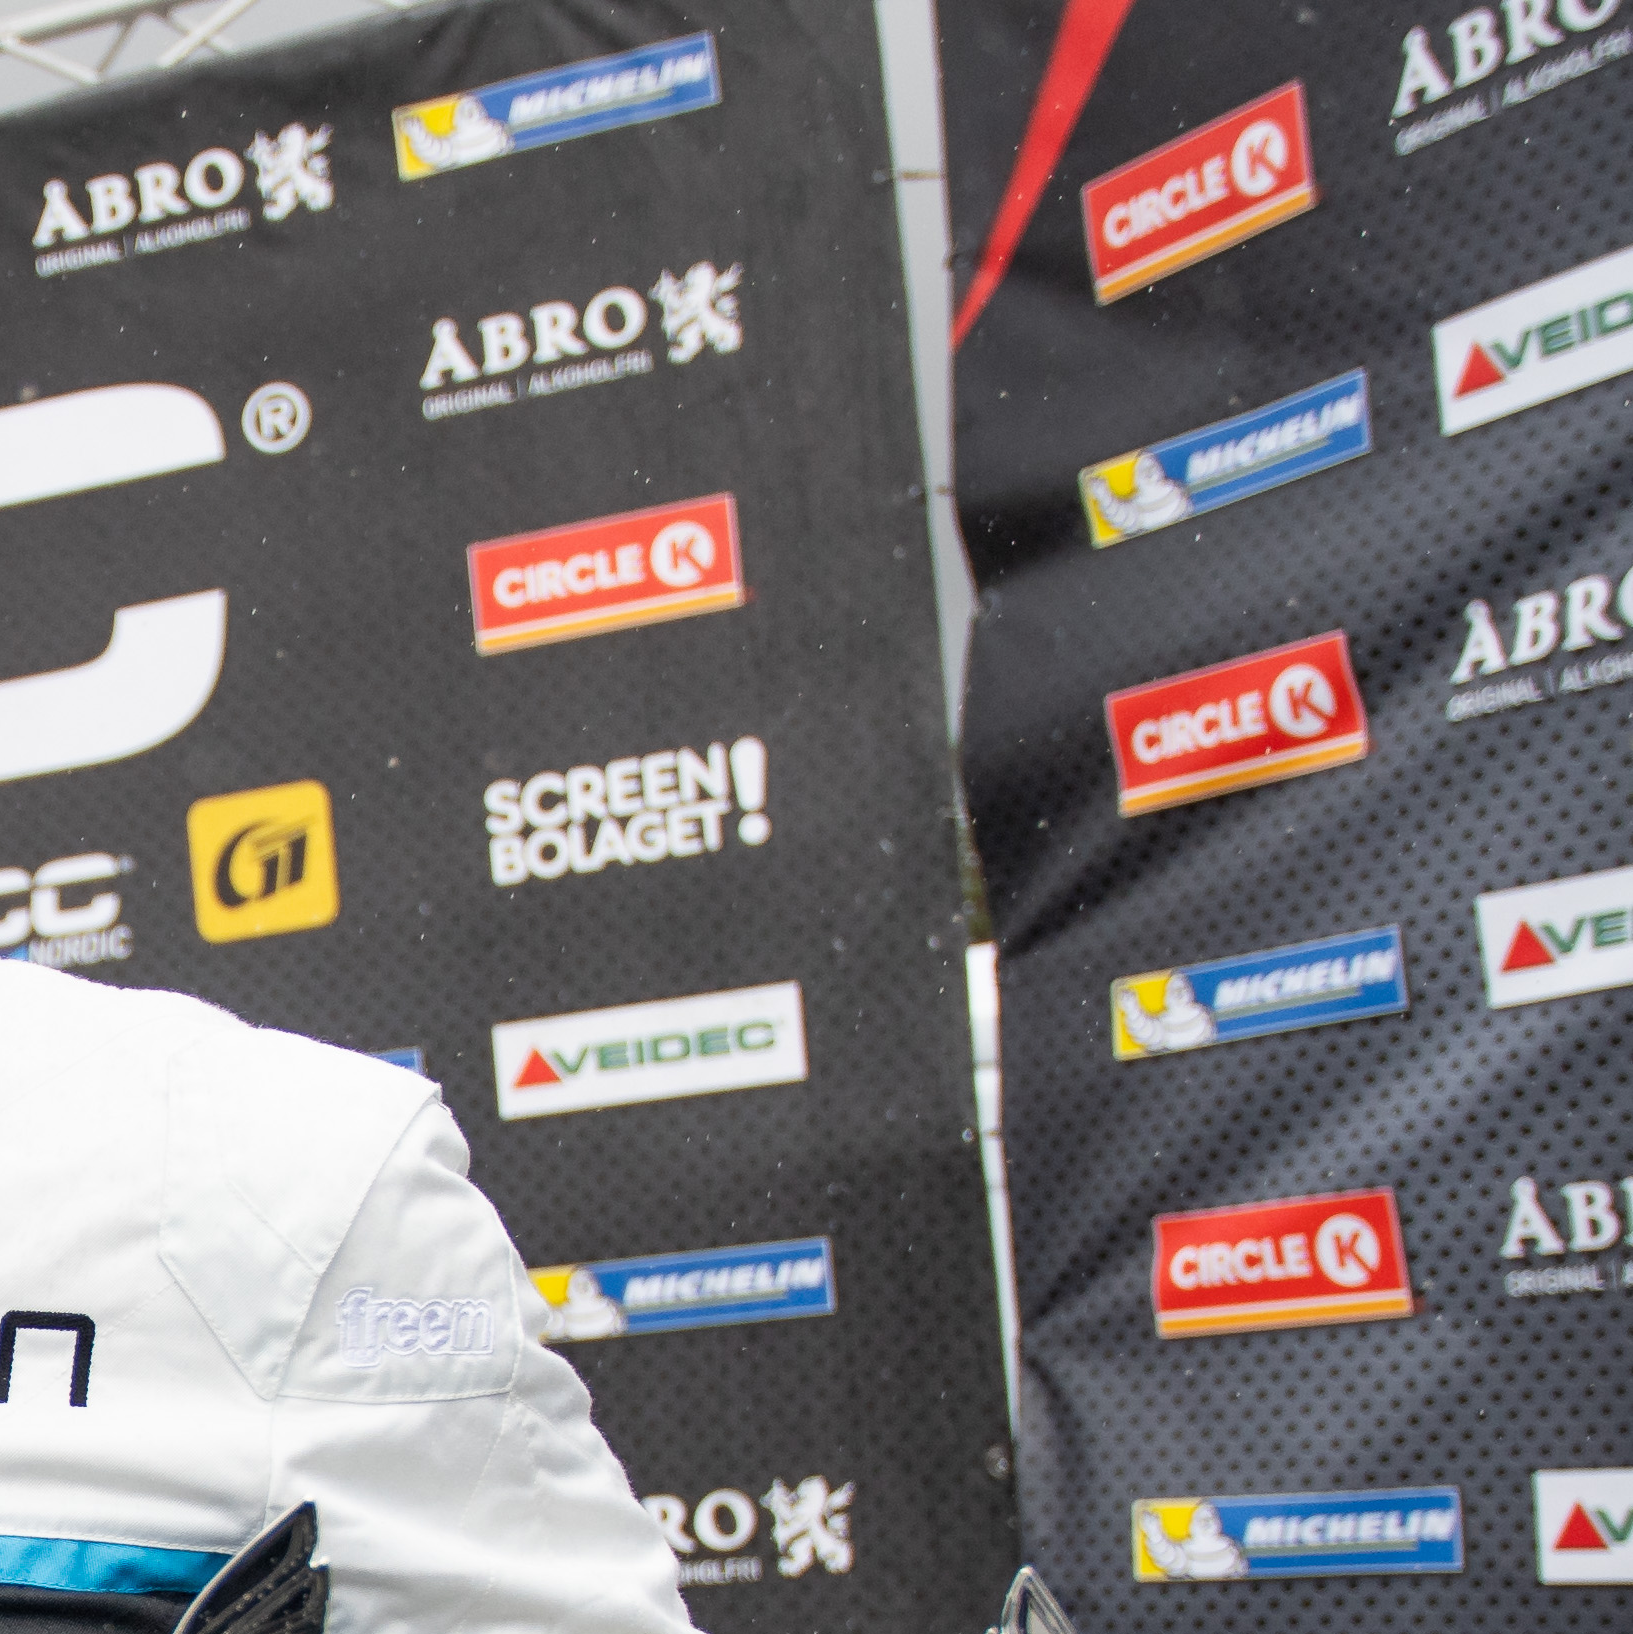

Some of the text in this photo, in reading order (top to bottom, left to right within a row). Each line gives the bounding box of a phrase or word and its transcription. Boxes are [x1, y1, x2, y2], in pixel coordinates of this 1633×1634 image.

[509, 53, 710, 122] MICHELIN
[1103, 119, 1288, 250] CIRCLE K
[1490, 289, 1633, 371] VEID
[1187, 394, 1360, 482] MICHELIN
[493, 521, 715, 608] CIRCLE K
[1449, 566, 1633, 686] ÅBR
[1132, 662, 1336, 763] CIRCLE K
[483, 742, 730, 837] SCREEN
[1215, 949, 1396, 1009] MICHELIN
[554, 1021, 777, 1076] VEIDEC
[624, 1258, 824, 1303] MICHELIN
[1170, 1212, 1381, 1290] CIRCLE K
[335, 1286, 495, 1369] freem
[1244, 1509, 1454, 1546] MICHELIN
